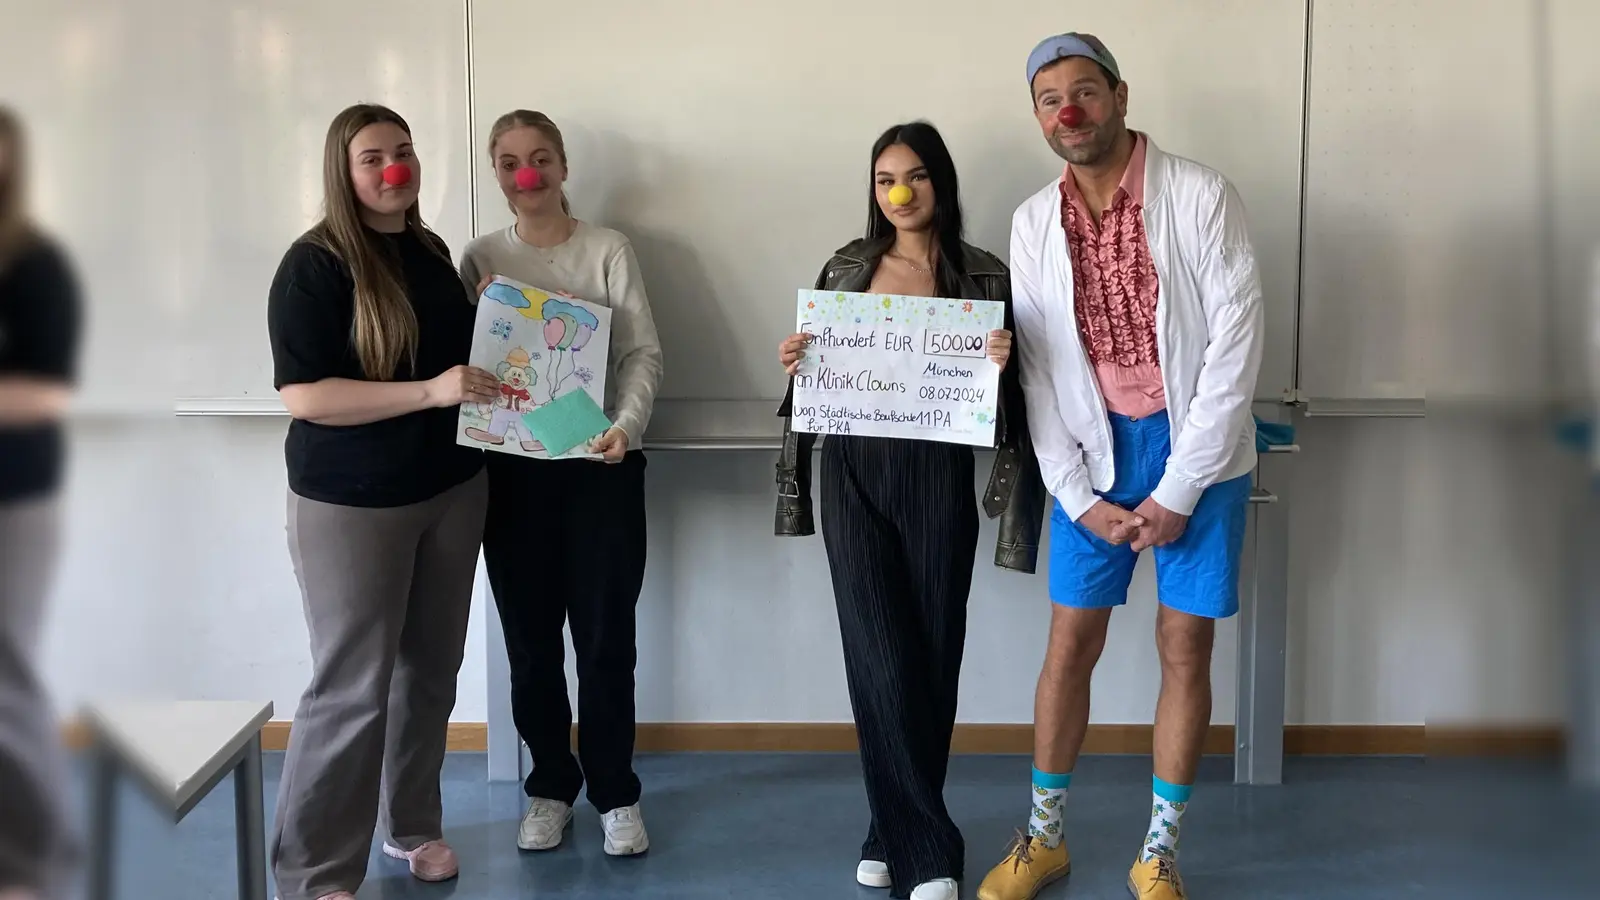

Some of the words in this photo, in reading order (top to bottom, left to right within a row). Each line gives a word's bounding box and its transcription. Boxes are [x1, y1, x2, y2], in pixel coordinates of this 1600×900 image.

[885, 332, 914, 353] EUR
[931, 334, 983, 354] 500,00
[923, 361, 973, 378] München
[796, 374, 813, 389] an
[919, 386, 985, 403] 08.07.2024
[793, 404, 816, 418] von
[819, 403, 872, 421] Städtische
[807, 417, 825, 432] für
[828, 418, 851, 435] PKA
